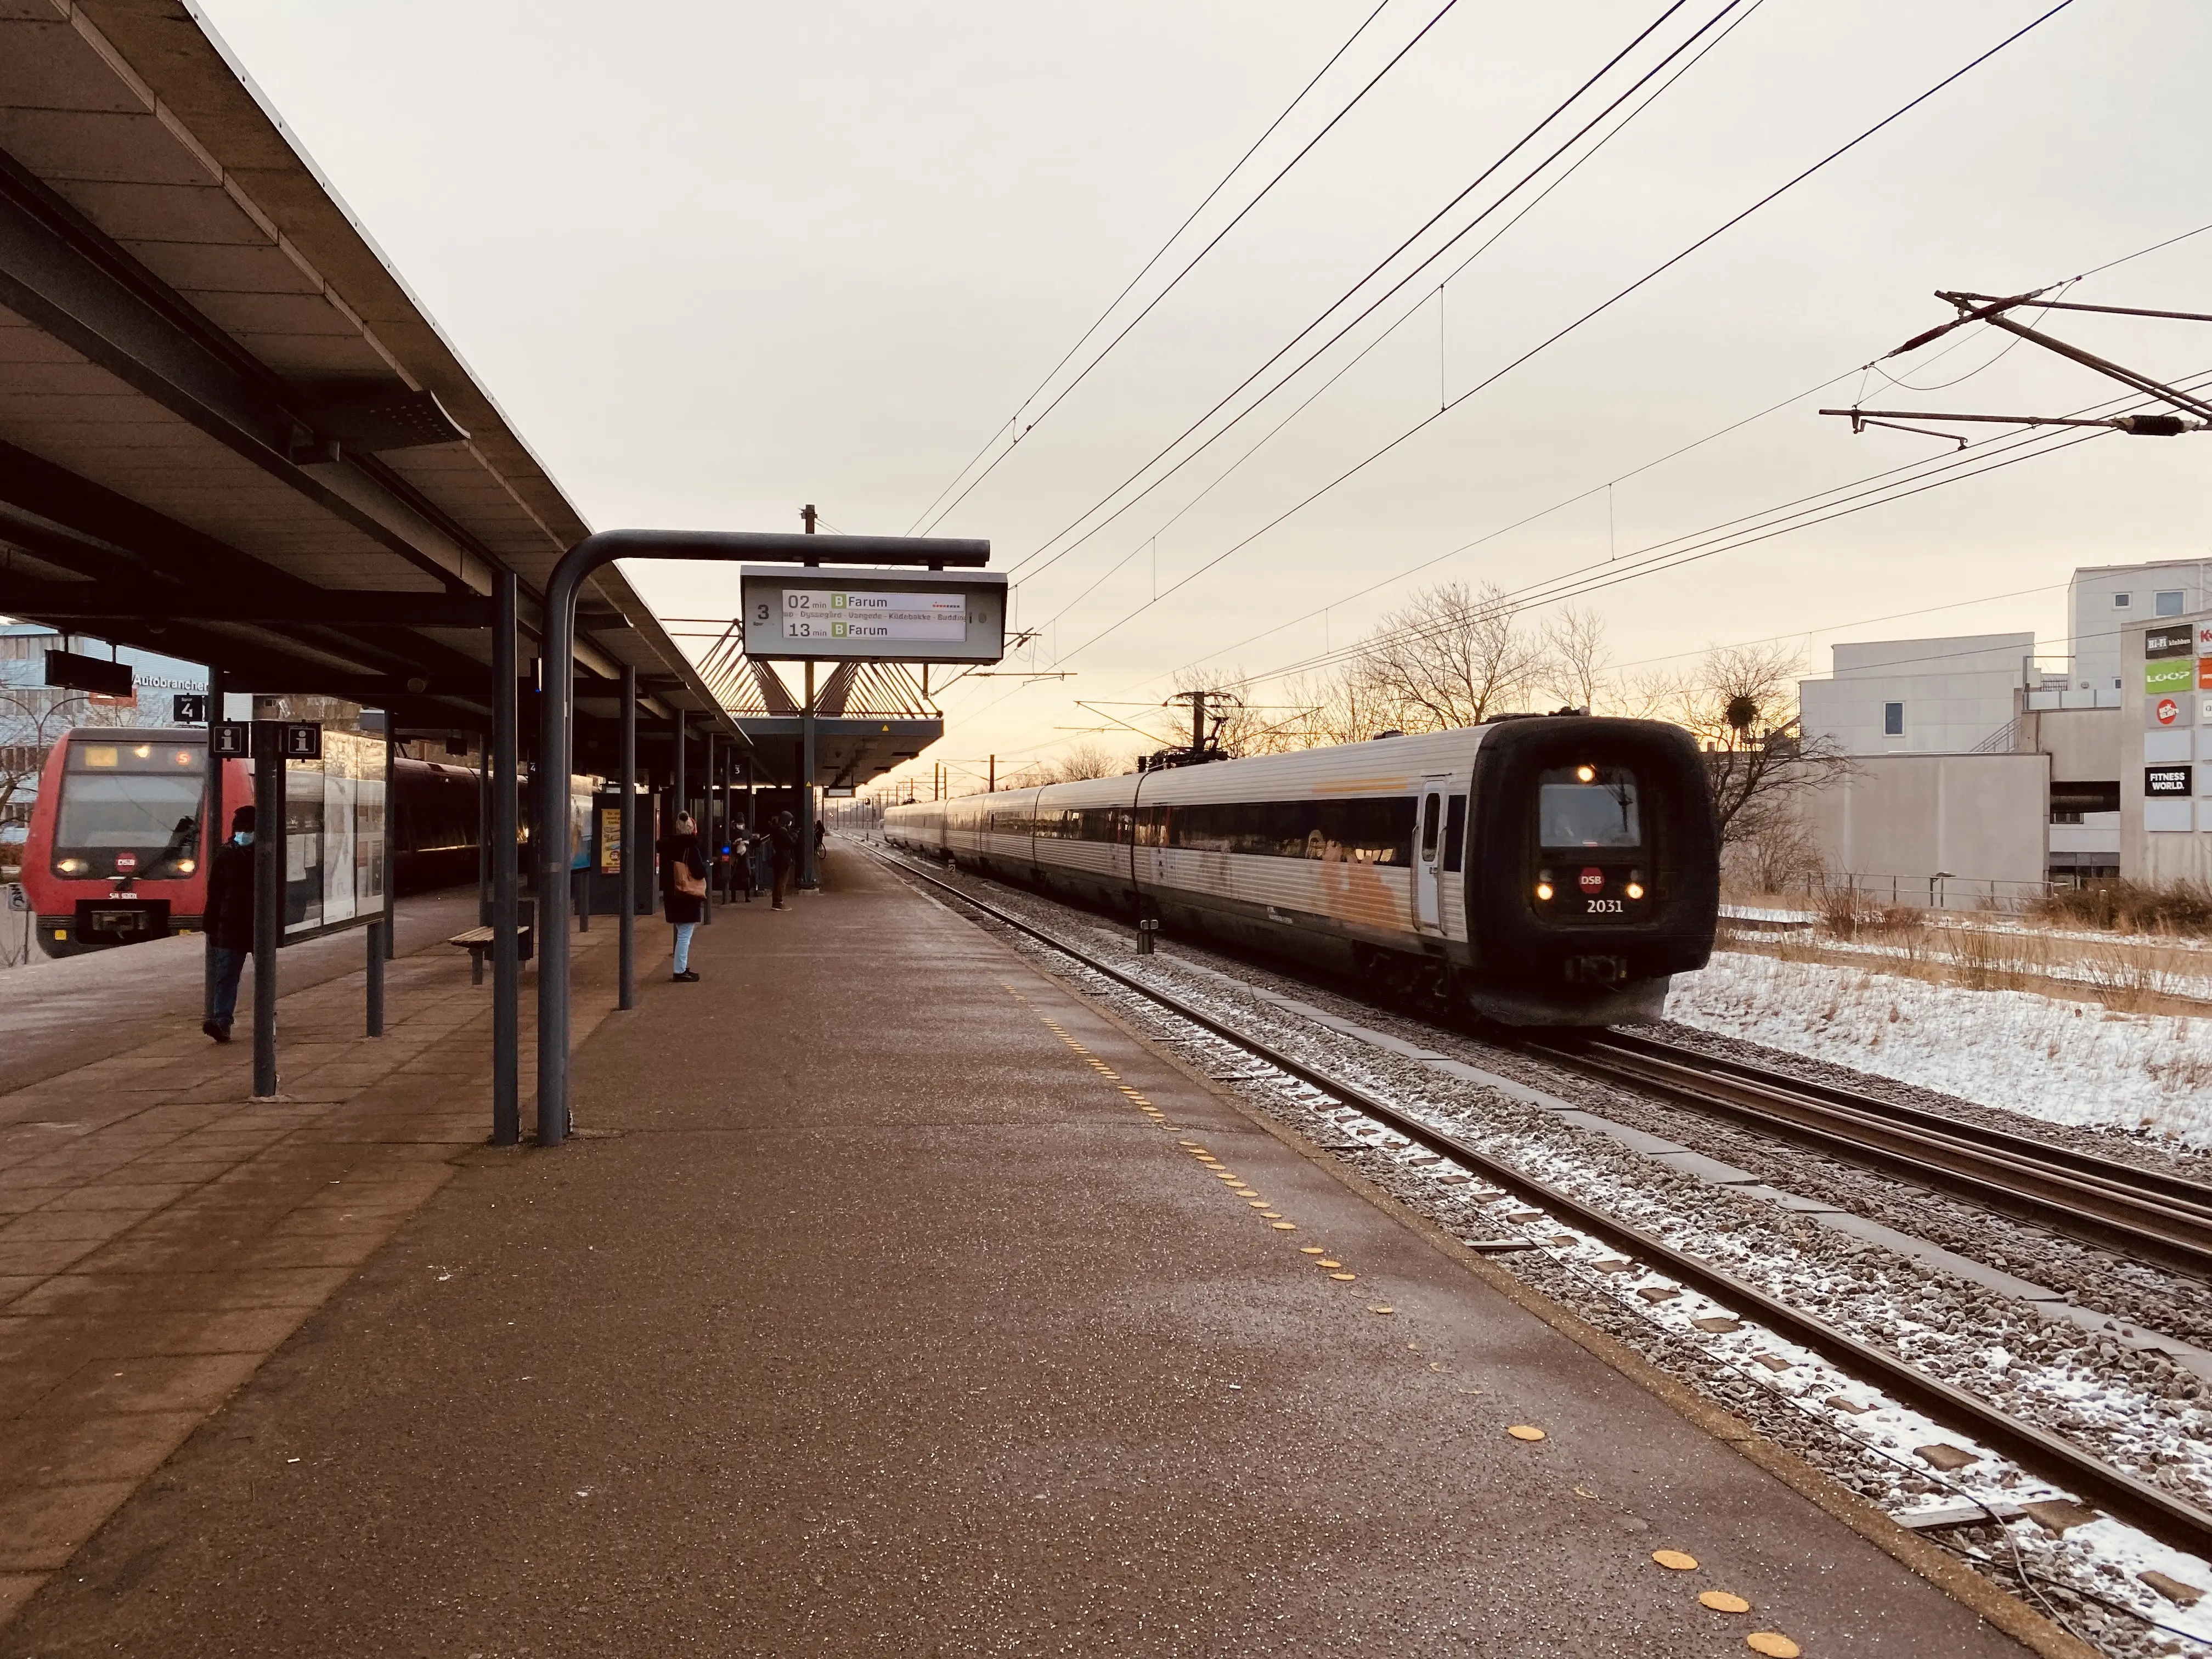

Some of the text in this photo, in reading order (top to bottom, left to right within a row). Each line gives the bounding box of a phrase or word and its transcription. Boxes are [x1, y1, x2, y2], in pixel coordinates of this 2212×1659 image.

[788, 595, 810, 609] 02
[834, 596, 844, 607] B
[849, 596, 887, 607] Farum
[758, 604, 769, 619] 3
[789, 623, 810, 636] 13
[835, 624, 844, 635] B
[849, 625, 888, 635] Farum
[2148, 638, 2166, 649] Hi-Fi
[2147, 671, 2190, 682] LOOP
[182, 703, 193, 718] 4
[2150, 772, 2185, 781] FITNESS
[1581, 876, 1602, 885] DSB
[1587, 900, 1623, 913] 2031
